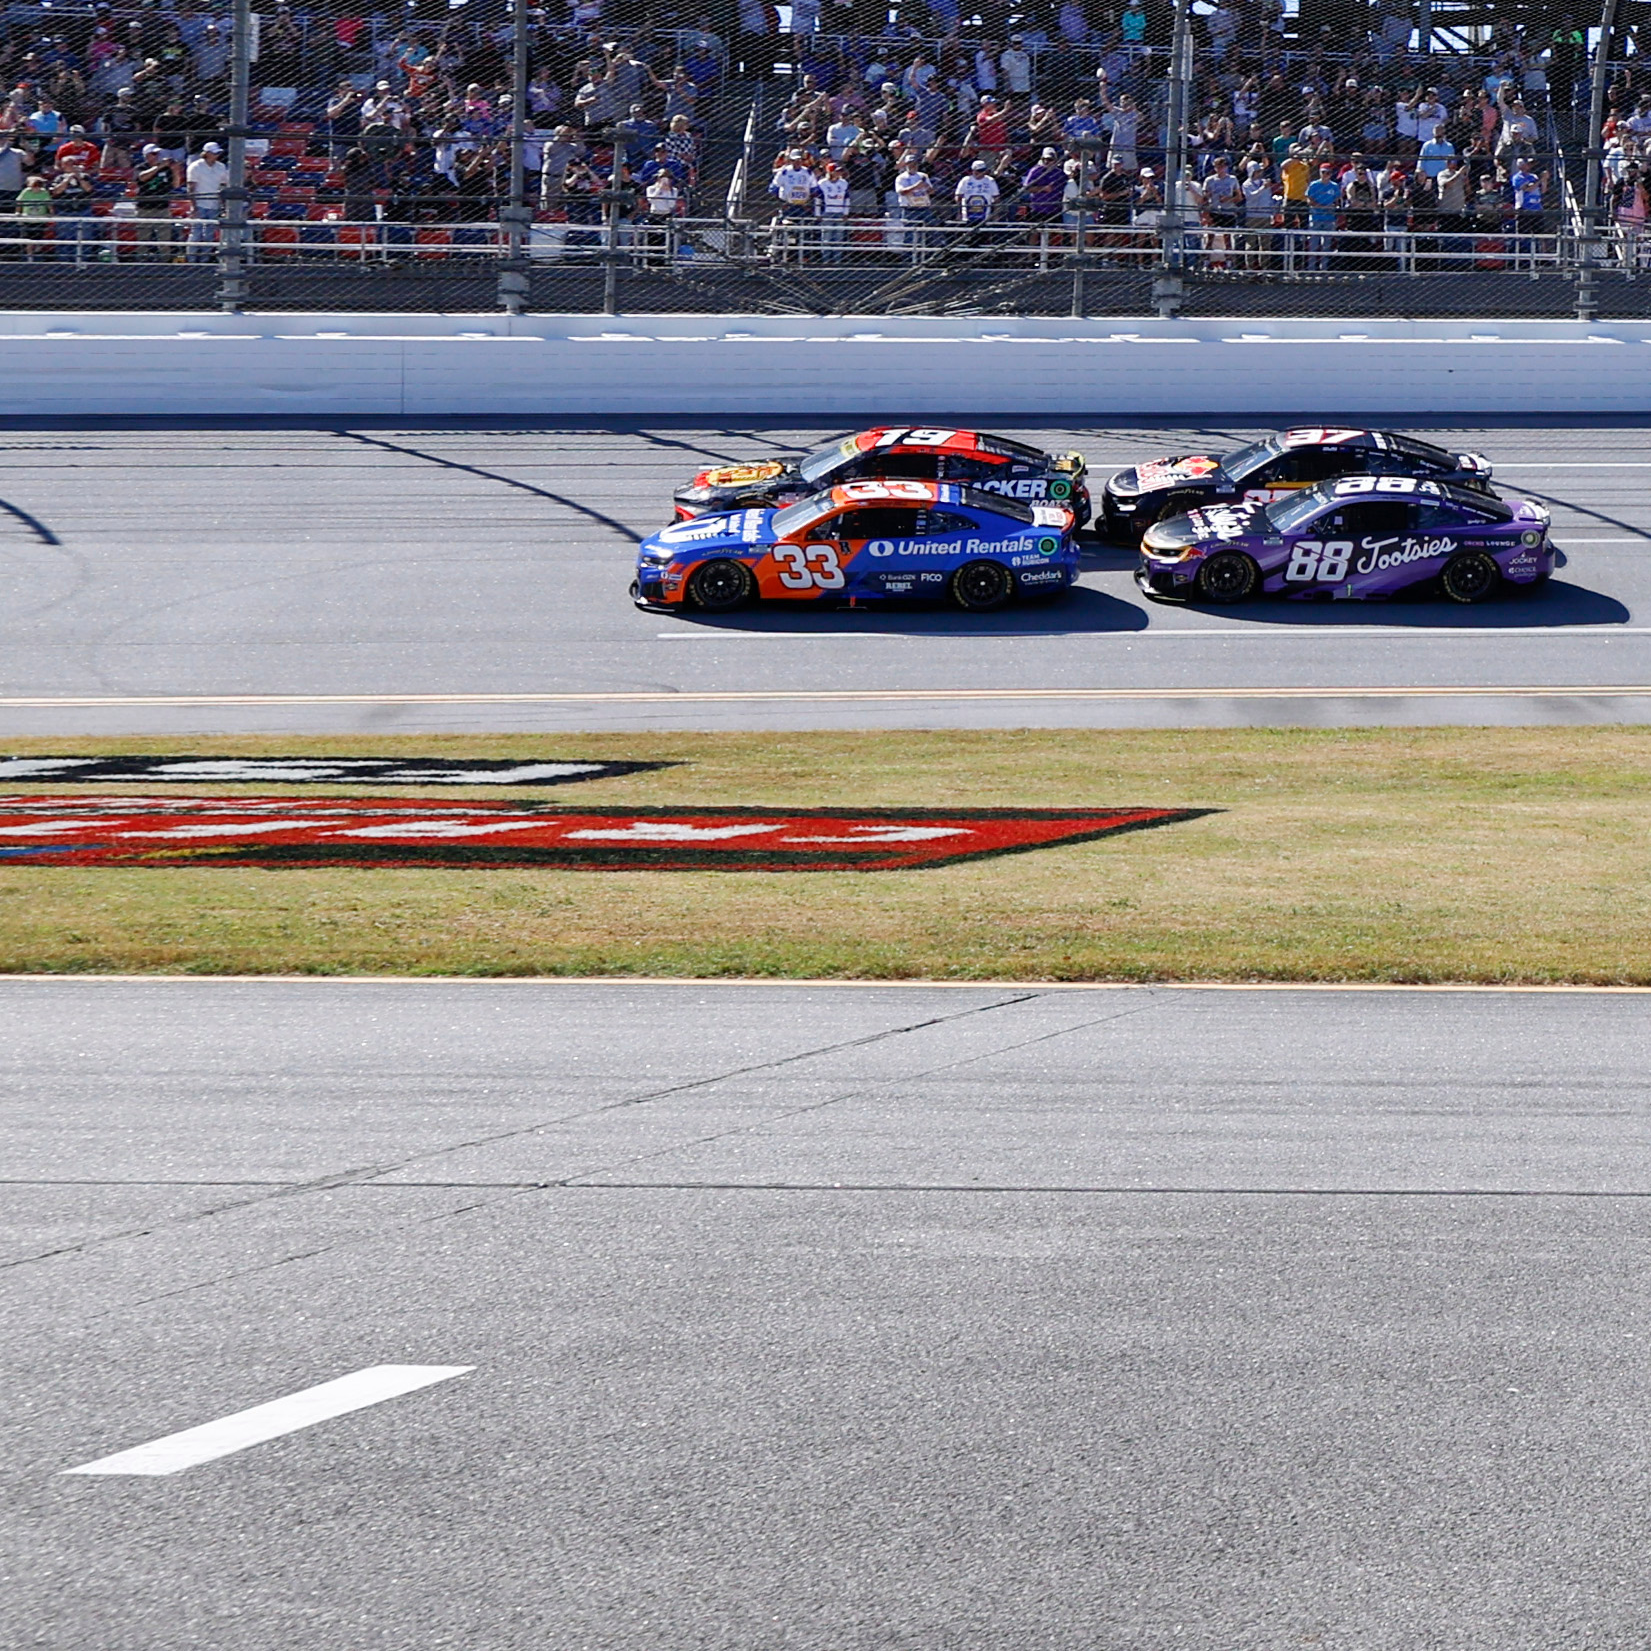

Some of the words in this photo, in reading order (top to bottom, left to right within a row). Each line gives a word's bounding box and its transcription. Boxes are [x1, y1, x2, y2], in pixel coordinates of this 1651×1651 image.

[876, 429, 957, 447] 19
[844, 480, 933, 499] 33
[1334, 475, 1417, 495] 88
[898, 539, 960, 557] United
[965, 536, 1033, 555] Rentals
[1356, 536, 1458, 575] Tootsies
[771, 544, 846, 590] 33
[1021, 558, 1049, 566] RUBICON
[1285, 541, 1354, 582] 88
[885, 582, 913, 590] REBEL
[920, 573, 943, 582] FICO
